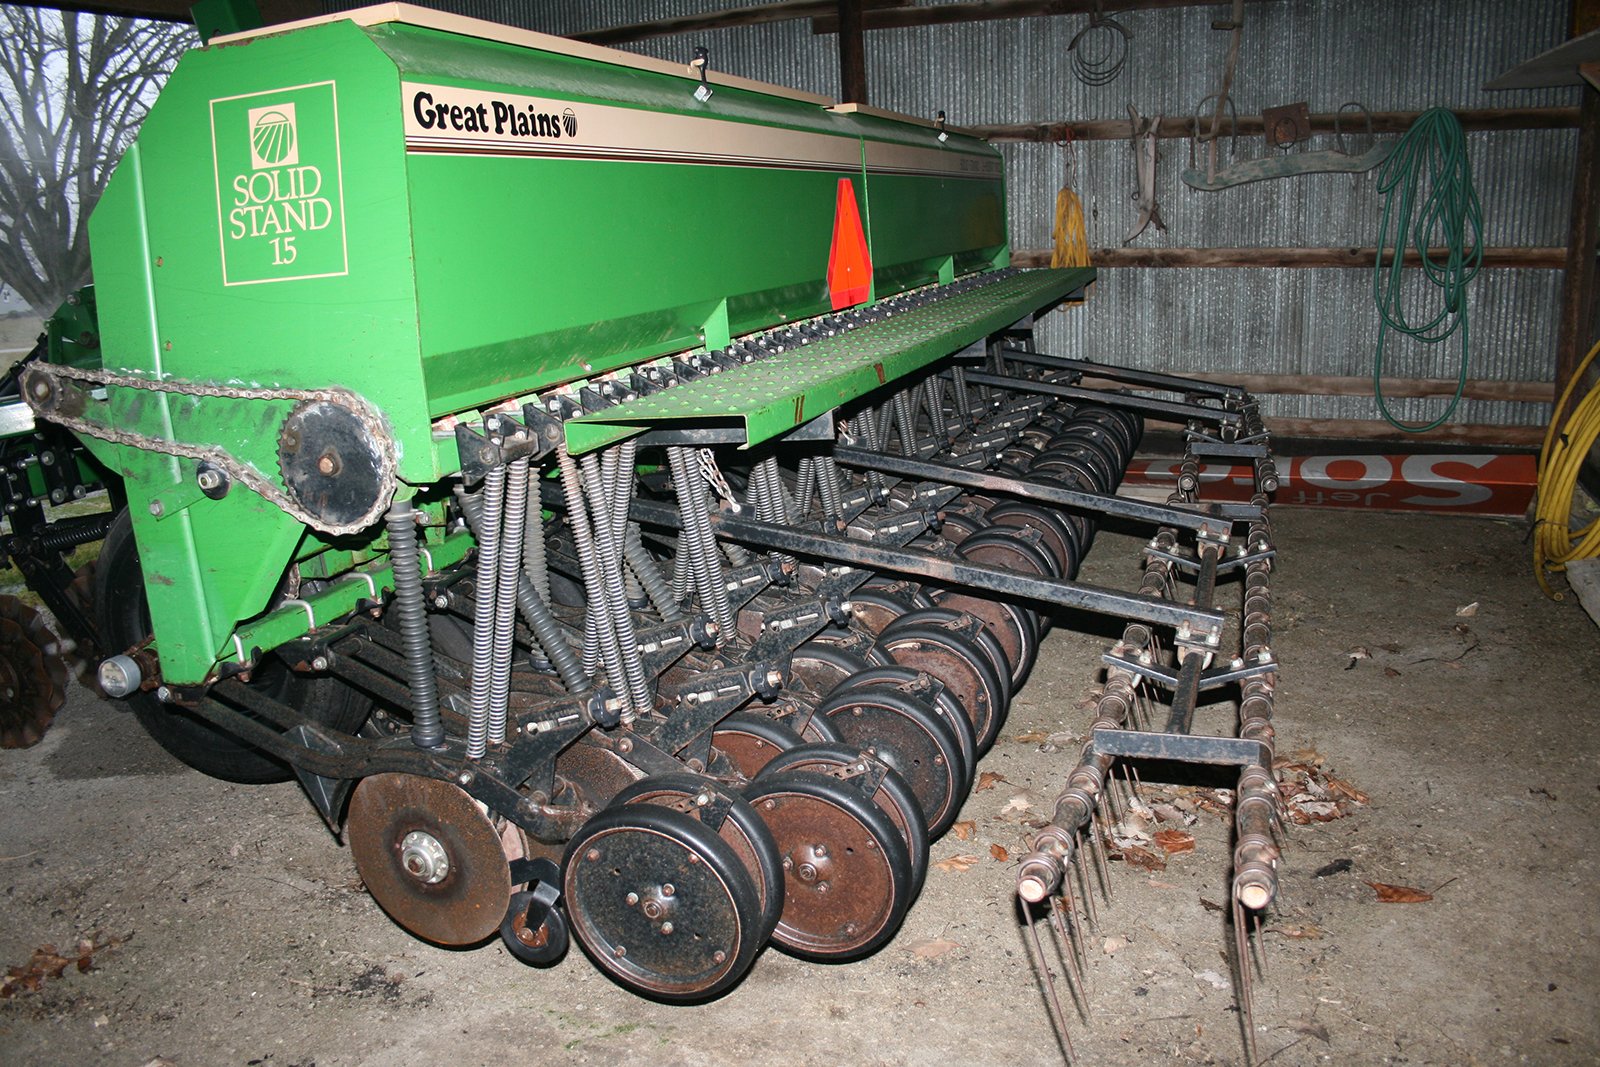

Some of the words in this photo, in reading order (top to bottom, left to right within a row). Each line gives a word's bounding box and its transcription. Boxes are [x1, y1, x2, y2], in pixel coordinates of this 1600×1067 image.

[413, 91, 489, 133] Great
[491, 100, 561, 138] Plains
[233, 165, 322, 206] SOLID
[229, 197, 332, 240] STAND
[268, 236, 298, 265] 15
[1292, 489, 1391, 506] Jeff
